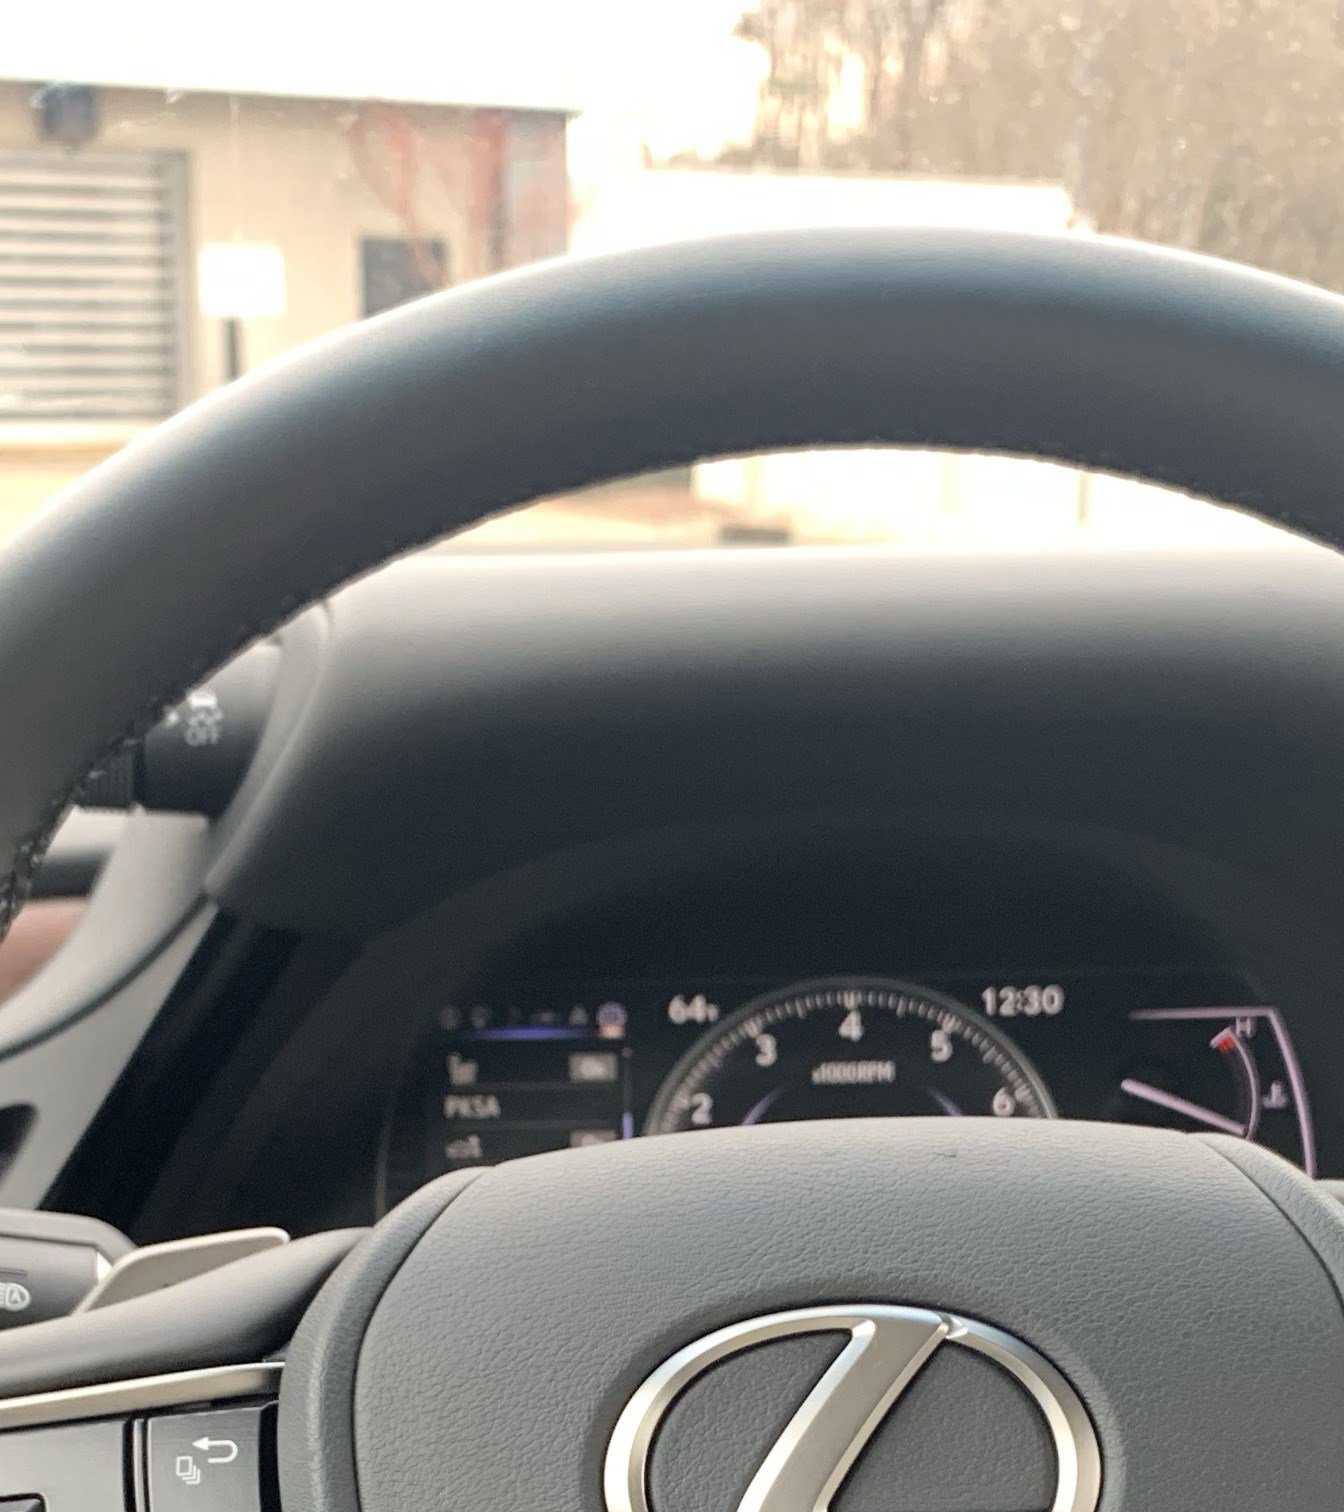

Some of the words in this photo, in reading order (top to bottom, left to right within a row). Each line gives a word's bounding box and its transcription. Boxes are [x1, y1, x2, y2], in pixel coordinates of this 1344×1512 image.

[982, 984, 1065, 1016] 12:30
[838, 1011, 864, 1041] 4
[756, 1033, 777, 1067] 3
[931, 1030, 954, 1063] 5
[690, 1092, 713, 1125] 2
[992, 1087, 1016, 1117] 6
